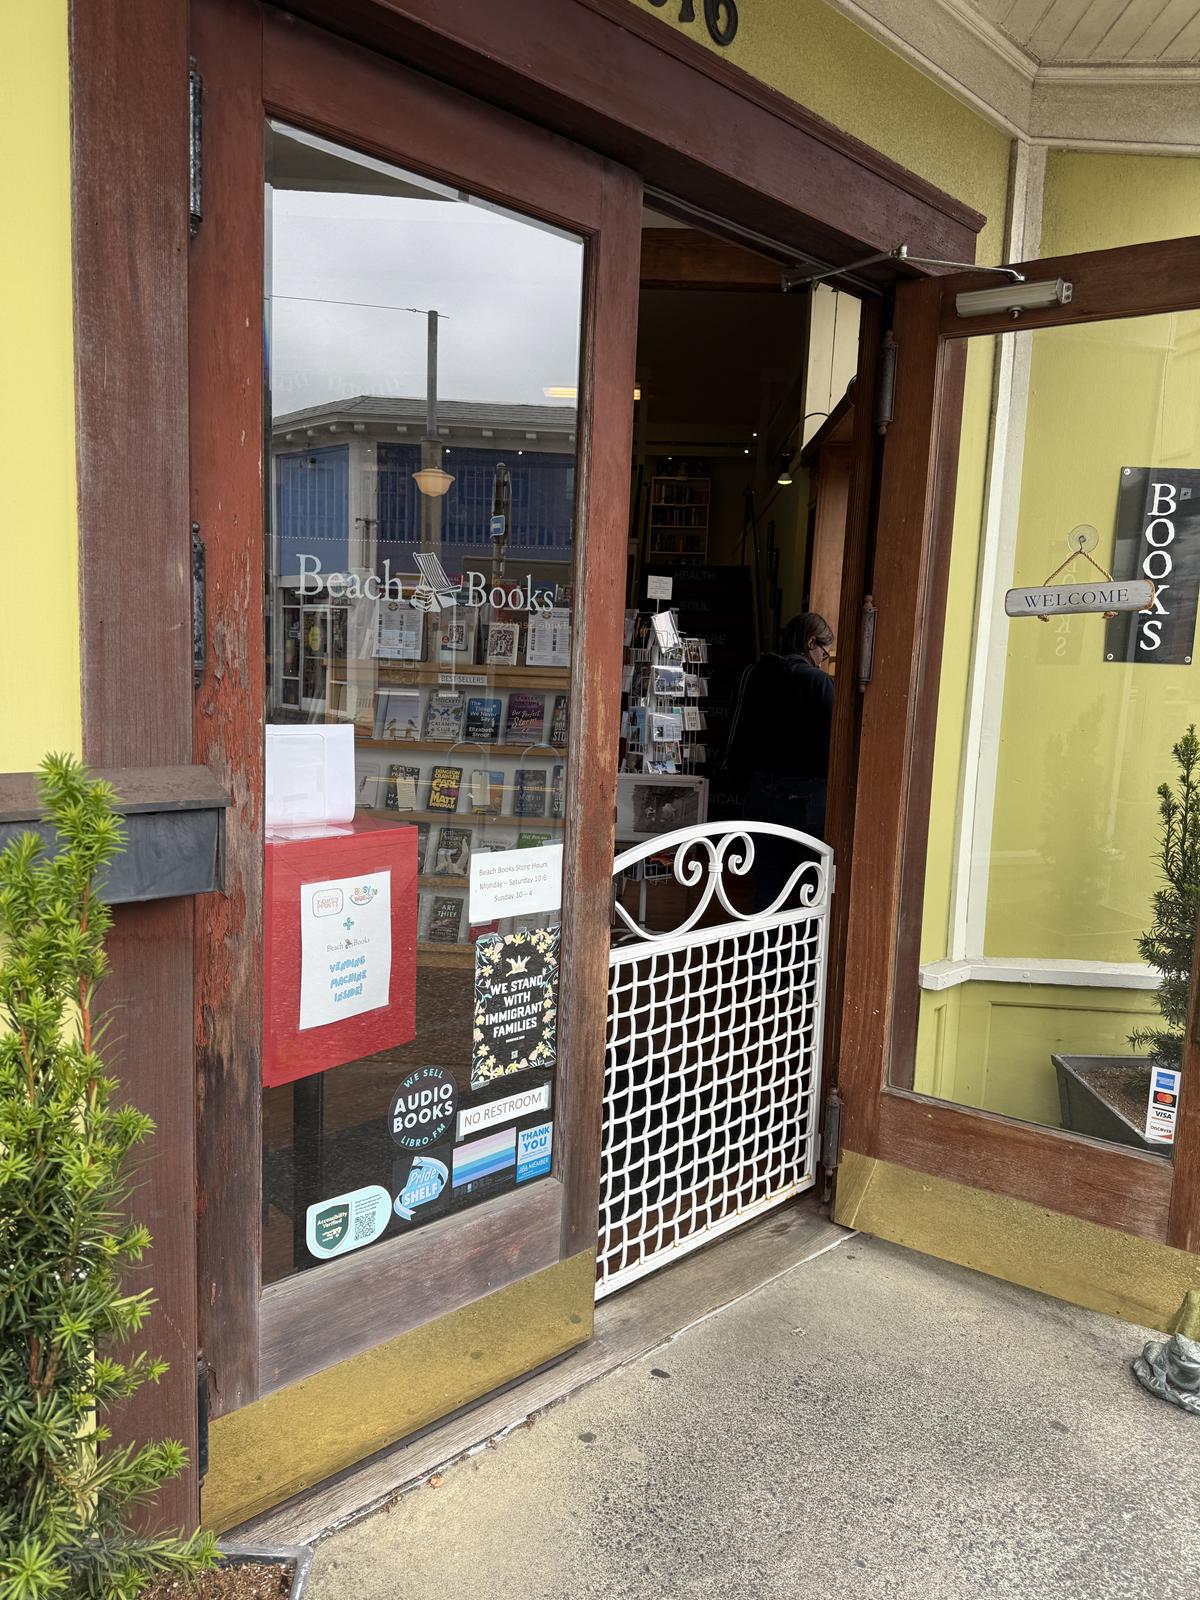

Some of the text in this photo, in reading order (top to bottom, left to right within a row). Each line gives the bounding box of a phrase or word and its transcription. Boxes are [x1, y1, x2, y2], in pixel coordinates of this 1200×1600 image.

[294, 553, 554, 612] Beach Books
[674, 570, 716, 582] HEALTH
[680, 600, 711, 612] SOUL
[1024, 588, 1130, 609] WELCOME
[441, 674, 485, 684] BEST SELLERS
[431, 778, 459, 791] CARL
[430, 790, 456, 804] MATT
[479, 862, 548, 876] Beach Books Store Hours
[479, 880, 503, 890] Monday
[508, 878, 534, 887] Saturday
[493, 892, 517, 903] Sunday
[437, 910, 457, 918] THIEF
[326, 937, 370, 952] Beach Books
[490, 974, 543, 996] WE STAND
[503, 991, 531, 1008] WITH
[485, 1000, 544, 1026] IMMIGRANT
[493, 1016, 537, 1038] FAMILIES
[403, 1068, 443, 1089] WE SELL
[393, 1083, 453, 1116] AUDIO
[393, 1100, 453, 1134] BOOKS
[464, 1092, 542, 1127] NO RESTROOM
[1155, 1111, 1172, 1120] VISA
[400, 1123, 446, 1147] LIBRO.FM
[521, 1126, 550, 1142] THANK
[523, 1136, 547, 1152] YOU
[408, 1166, 437, 1188] Pride
[403, 1182, 438, 1206] SHELF
[317, 1211, 348, 1226] Accessibility
